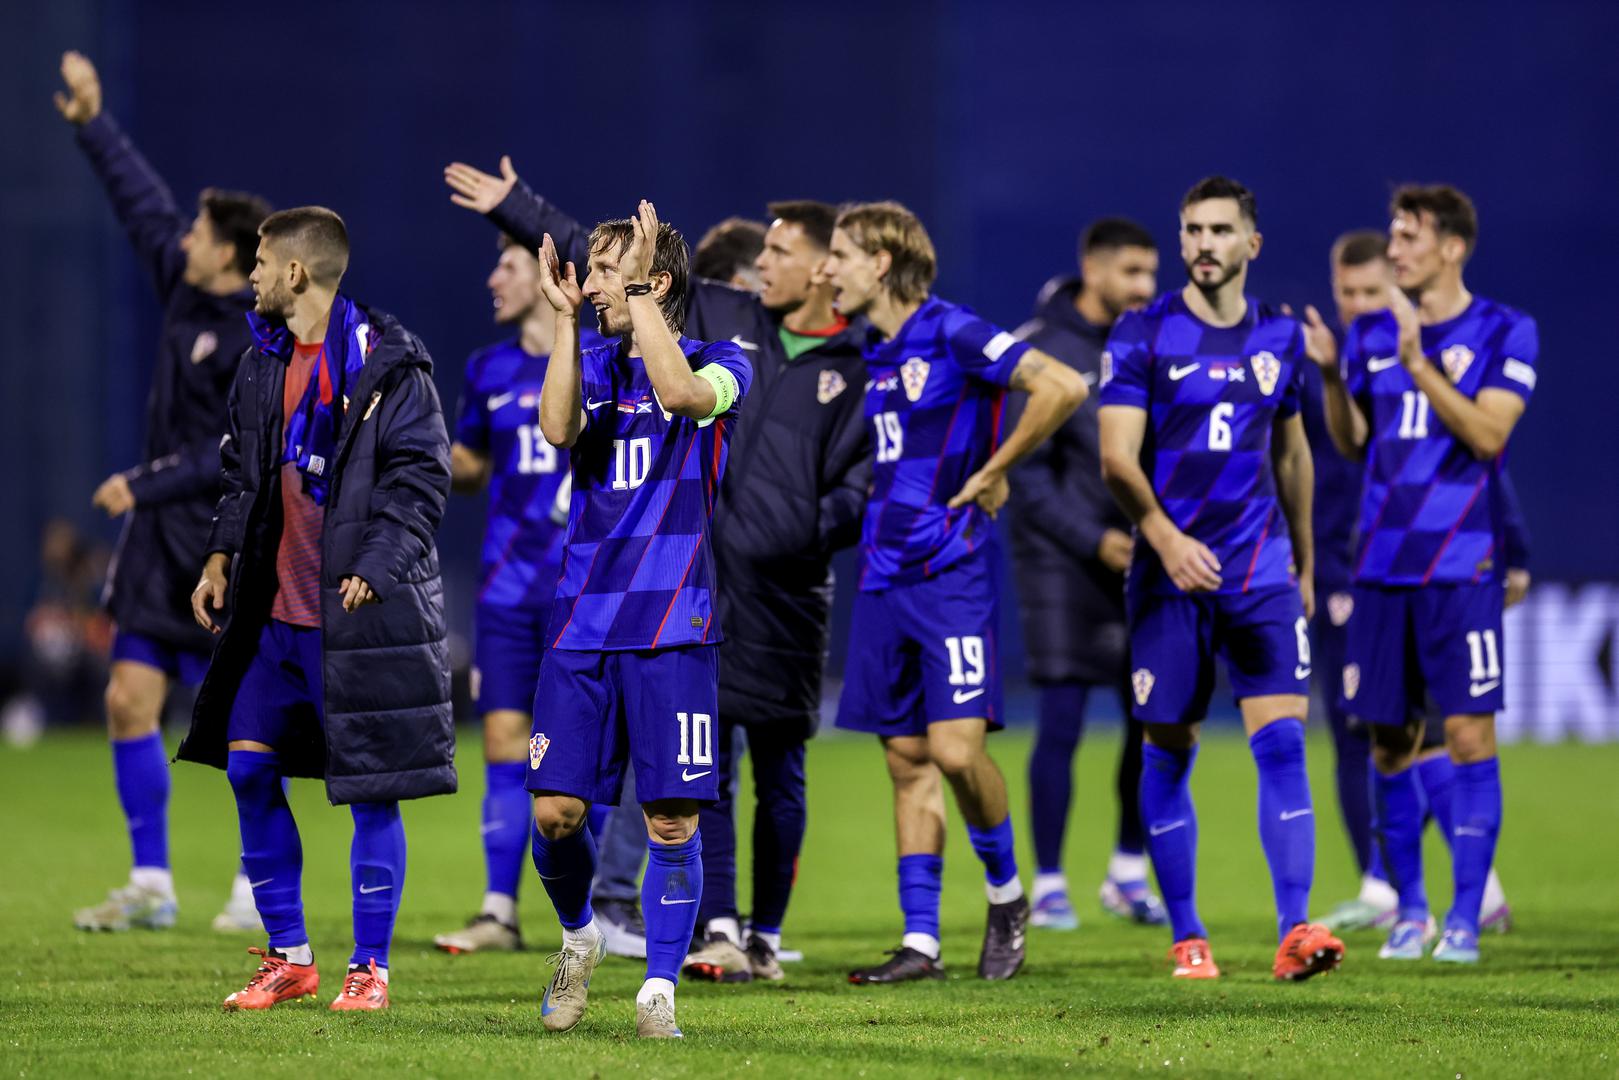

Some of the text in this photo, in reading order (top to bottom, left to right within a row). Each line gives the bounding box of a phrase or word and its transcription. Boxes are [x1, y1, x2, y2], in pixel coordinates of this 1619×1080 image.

[873, 411, 904, 463] 19
[1208, 402, 1235, 451] 6
[1398, 390, 1430, 440] 11
[517, 424, 557, 474] 13
[612, 437, 652, 490] 10
[944, 636, 986, 686] 19
[1466, 629, 1501, 680] 11
[676, 712, 713, 766] 10
